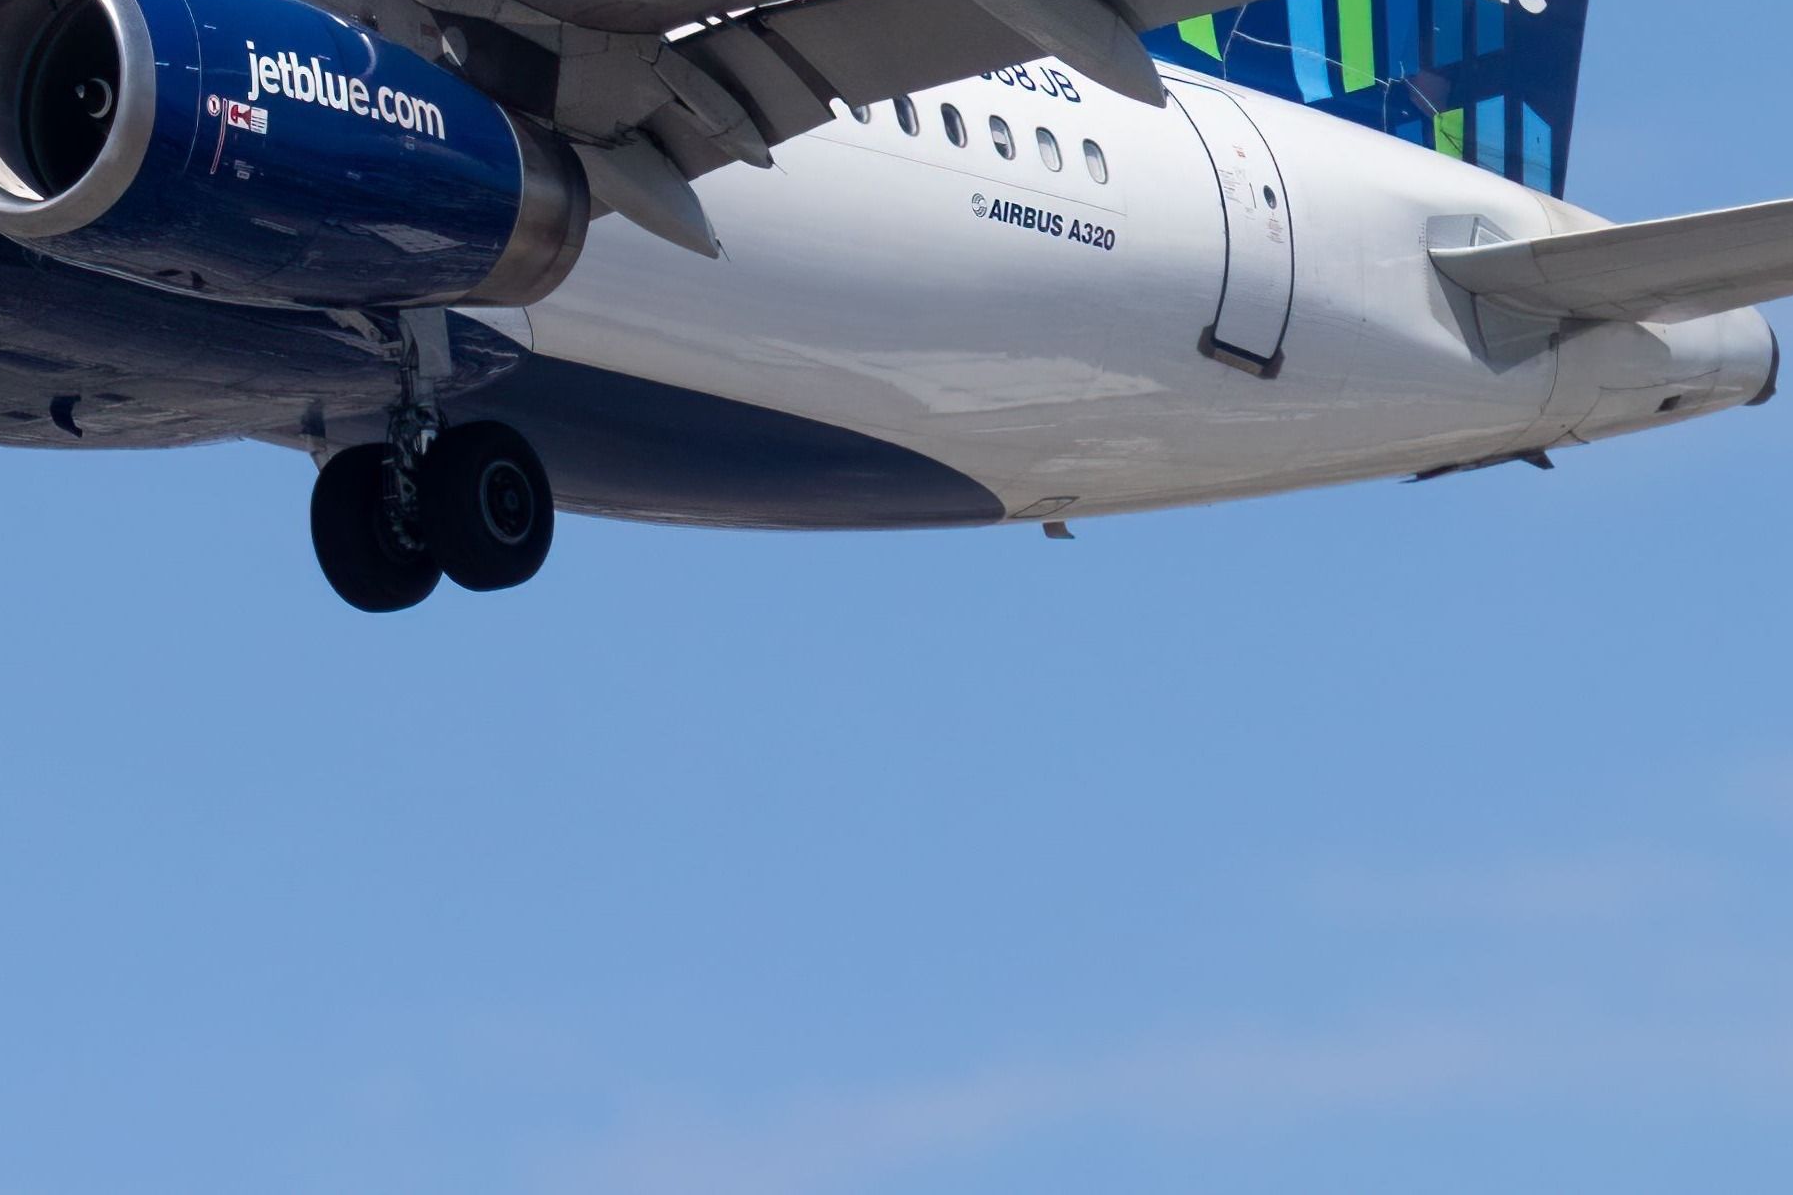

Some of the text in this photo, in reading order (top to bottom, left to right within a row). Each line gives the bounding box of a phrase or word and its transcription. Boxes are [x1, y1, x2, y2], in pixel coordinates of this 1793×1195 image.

[246, 39, 445, 140] jetblue.com
[989, 199, 1116, 251] AIRBUS A320
